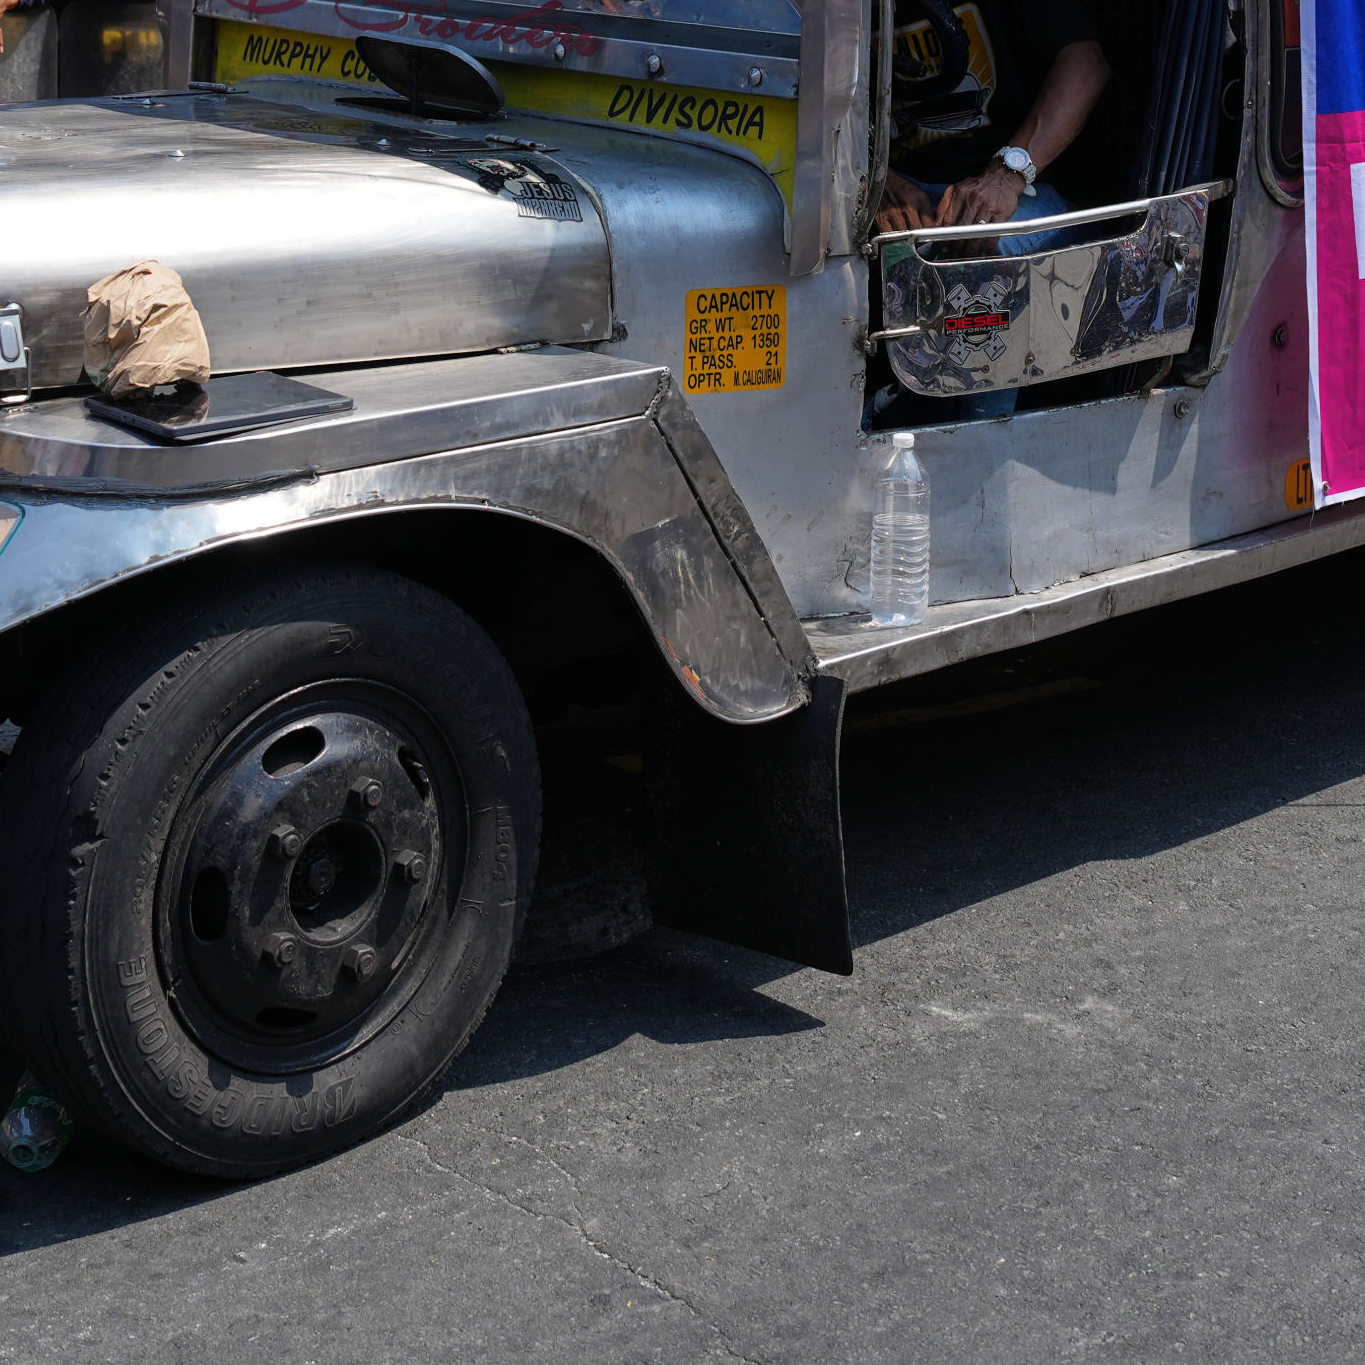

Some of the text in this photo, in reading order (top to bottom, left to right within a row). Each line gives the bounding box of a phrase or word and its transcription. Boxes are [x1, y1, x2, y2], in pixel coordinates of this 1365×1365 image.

[243, 35, 332, 73] MURPHY
[607, 84, 765, 141] DIVISORIA
[519, 180, 576, 201] JESUS
[696, 289, 775, 314] CAPACITY
[689, 314, 780, 335] GR. WT. 2700
[946, 314, 1009, 330] DIESEL
[946, 324, 1010, 335] PERFORMANCE
[689, 332, 780, 353] NET CAP. 1350
[688, 351, 779, 372] T. PASS. 21
[688, 372, 725, 389] OPTR.
[742, 367, 782, 386] CALIGUIRAN
[119, 951, 358, 1138] BRIDGESTONE
